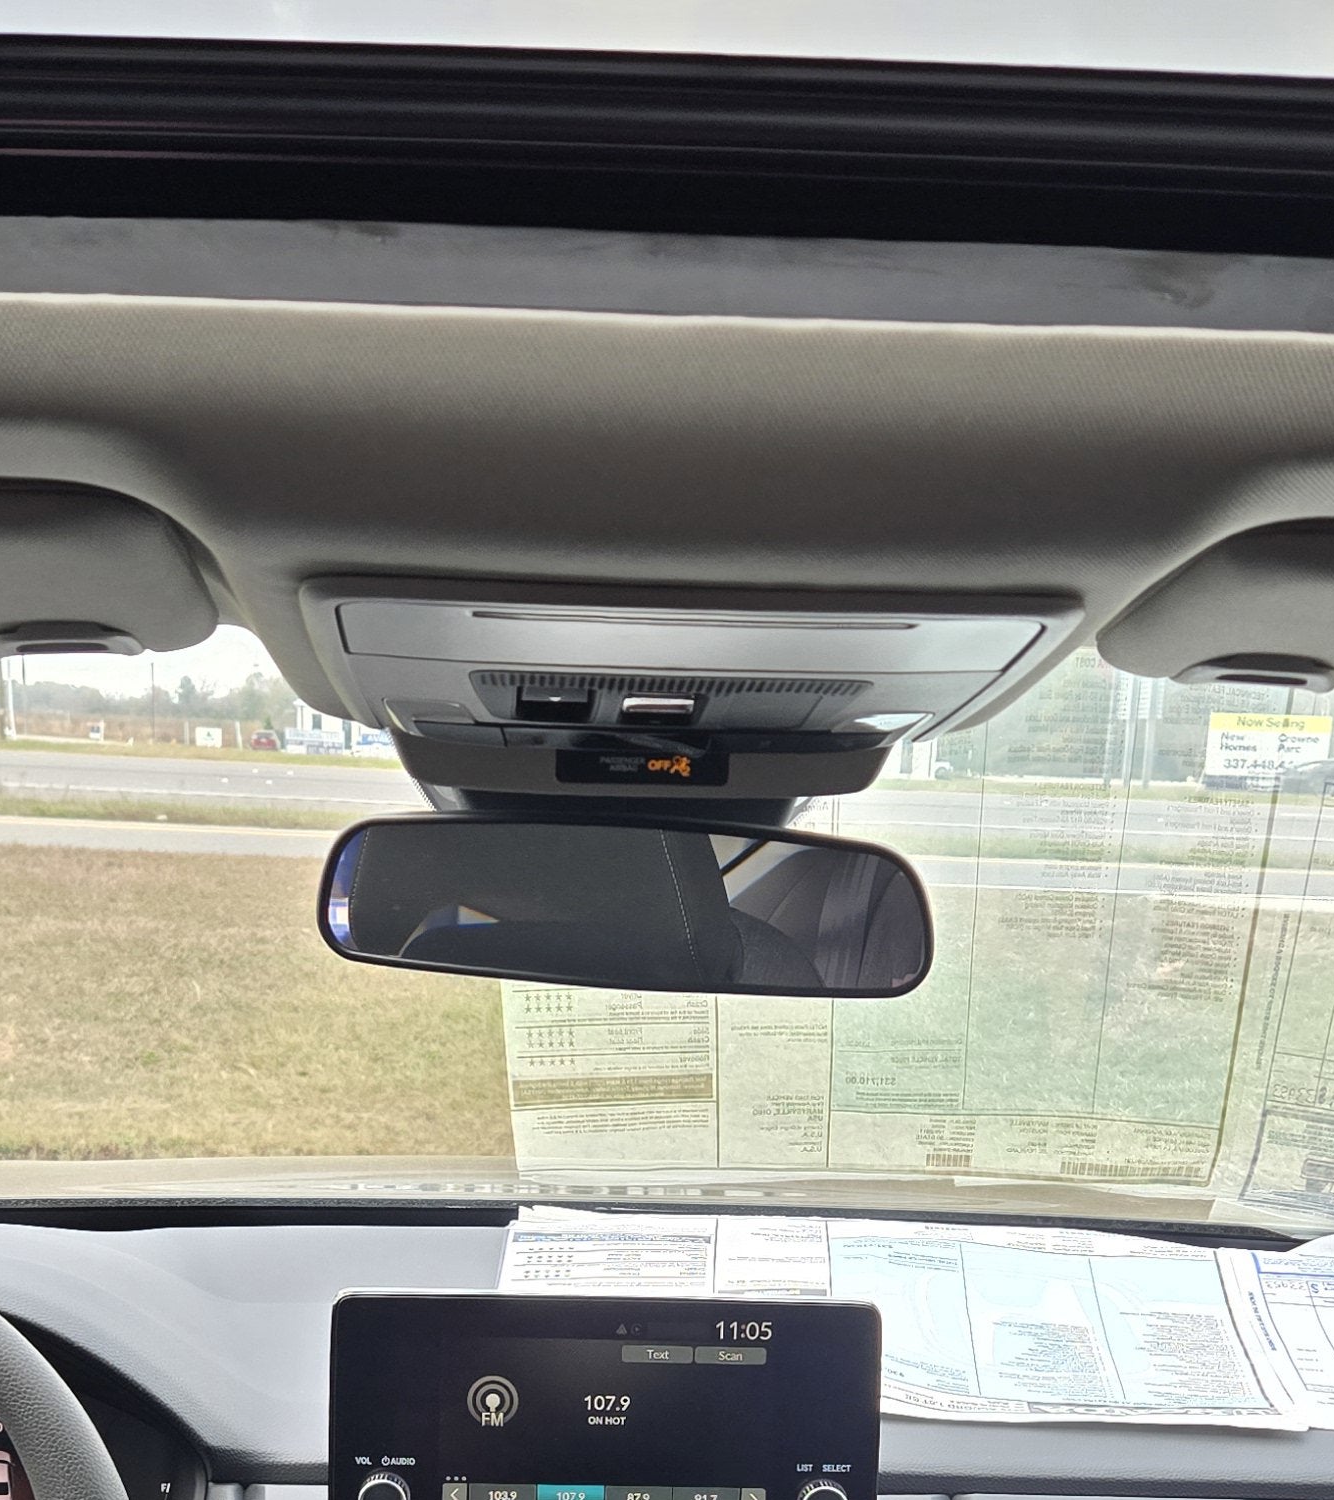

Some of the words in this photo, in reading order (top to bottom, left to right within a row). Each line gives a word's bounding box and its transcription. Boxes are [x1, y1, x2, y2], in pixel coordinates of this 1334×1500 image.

[1237, 716, 1263, 726] Now
[1221, 732, 1244, 741] New
[1220, 743, 1257, 752] Homes
[648, 759, 671, 771] OFF
[715, 1321, 772, 1340] 11:05
[647, 1349, 669, 1360] Text
[718, 1351, 742, 1361] Scan
[584, 1395, 631, 1411] 107.9
[481, 1412, 504, 1427] FM
[588, 1416, 603, 1425] ON
[605, 1416, 626, 1425] HOT
[355, 1457, 372, 1466] VOL
[391, 1457, 416, 1466] AUDIO
[796, 1464, 813, 1472] LIST
[822, 1464, 851, 1473] SELECT
[488, 1490, 517, 1500] 103.9
